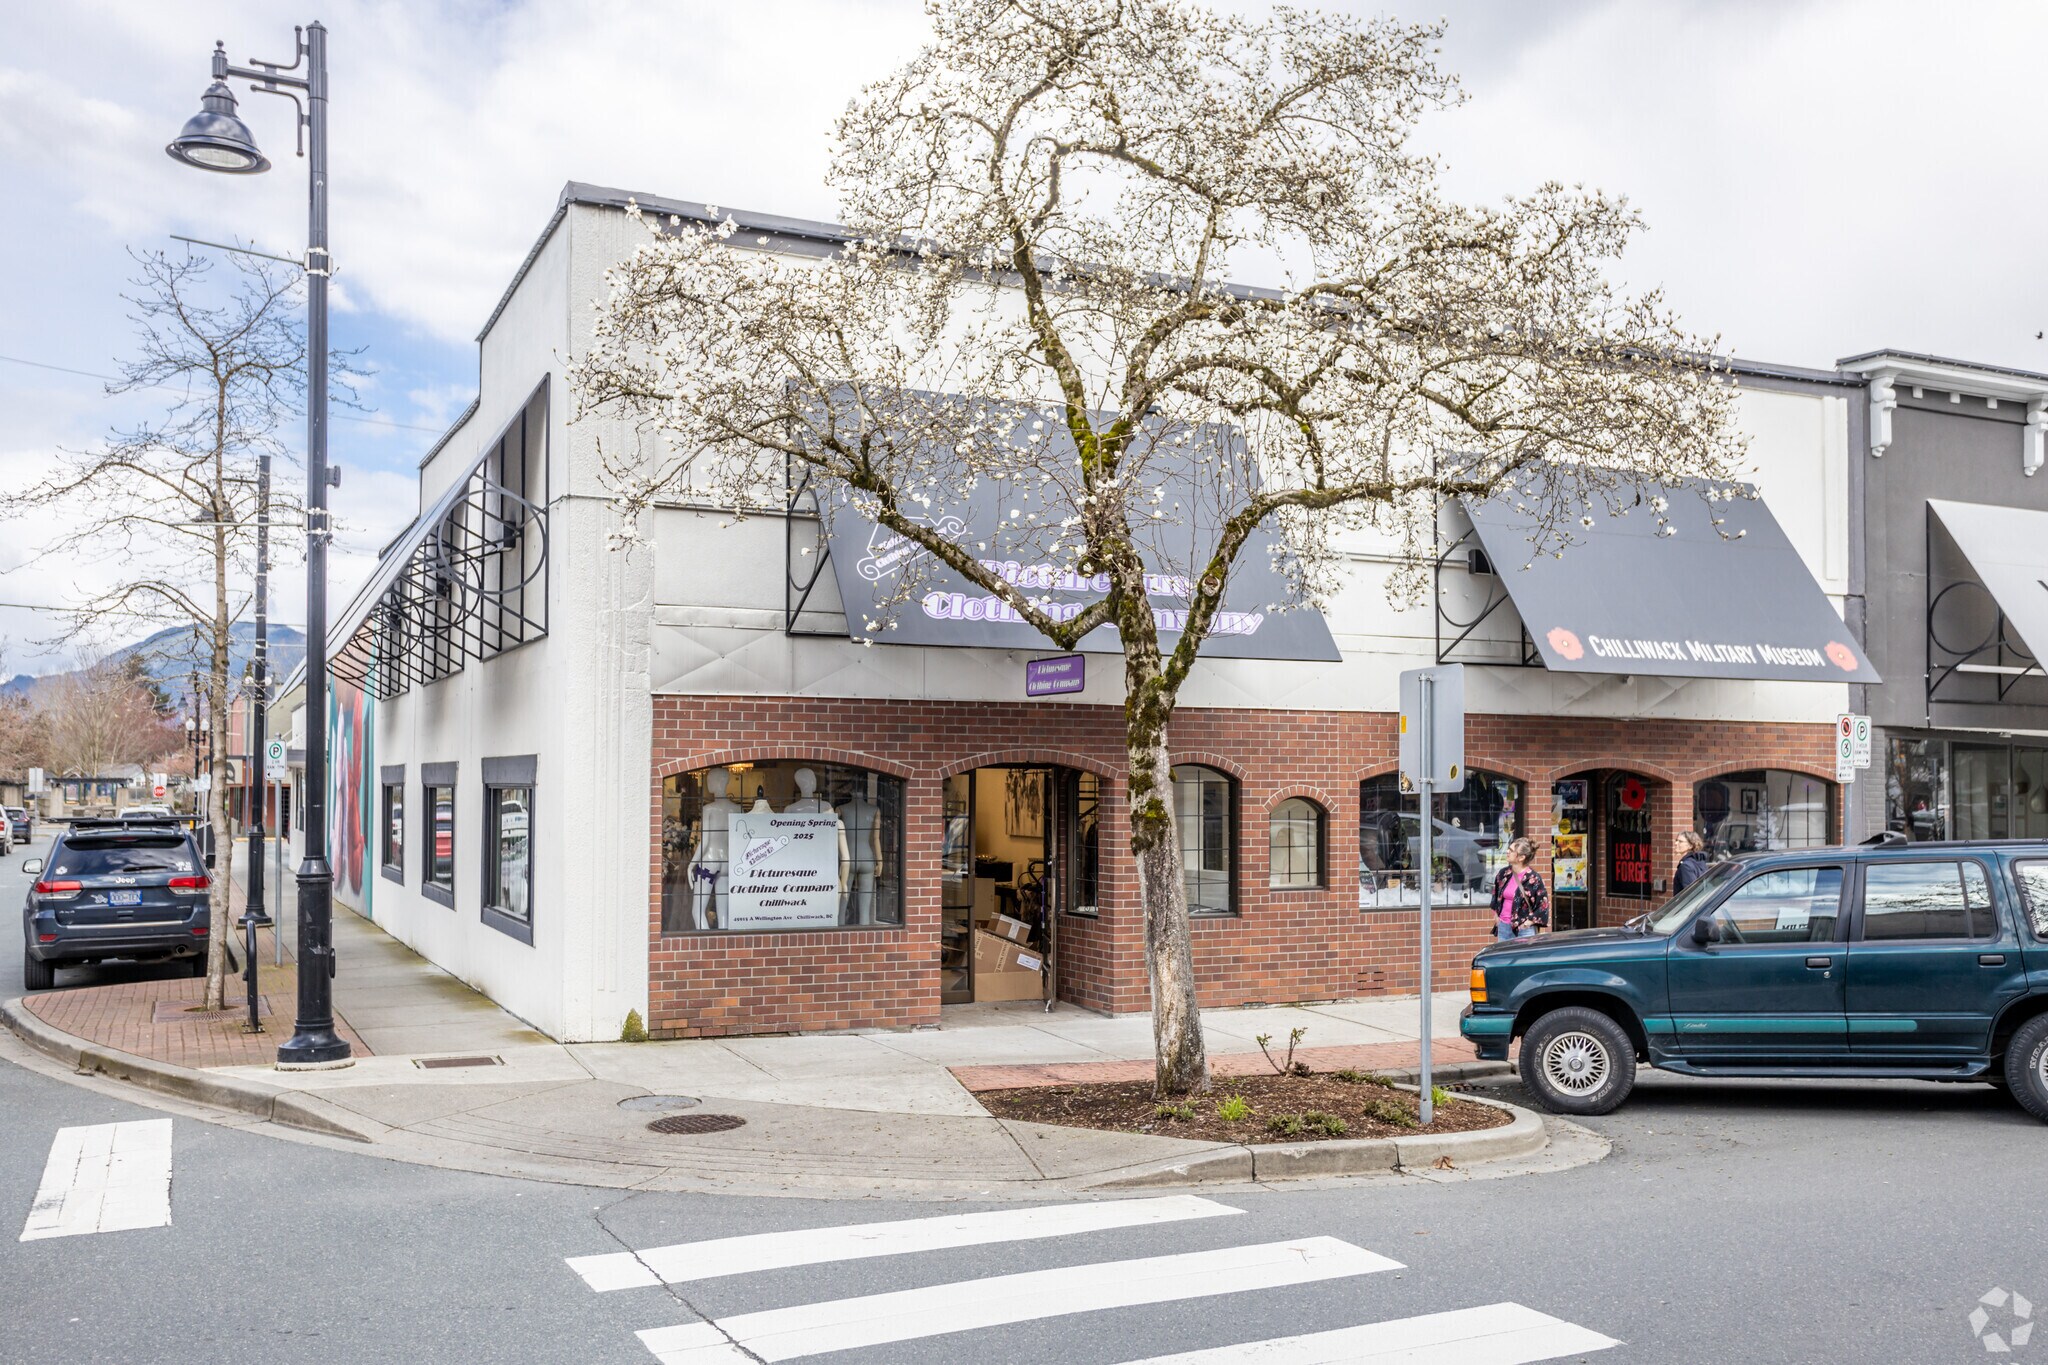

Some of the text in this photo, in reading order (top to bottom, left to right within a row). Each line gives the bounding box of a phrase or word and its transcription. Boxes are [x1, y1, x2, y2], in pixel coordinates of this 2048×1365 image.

[1588, 635, 1826, 667] CHILLIWACK MILITARY MUSEUM
[770, 819, 837, 828] Opening Spring
[1615, 843, 1636, 860] LEST
[749, 869, 818, 878] Picturesque
[115, 876, 136, 885] Jeep
[730, 884, 836, 894] Clothing Company
[759, 898, 807, 907] Chilliwack
